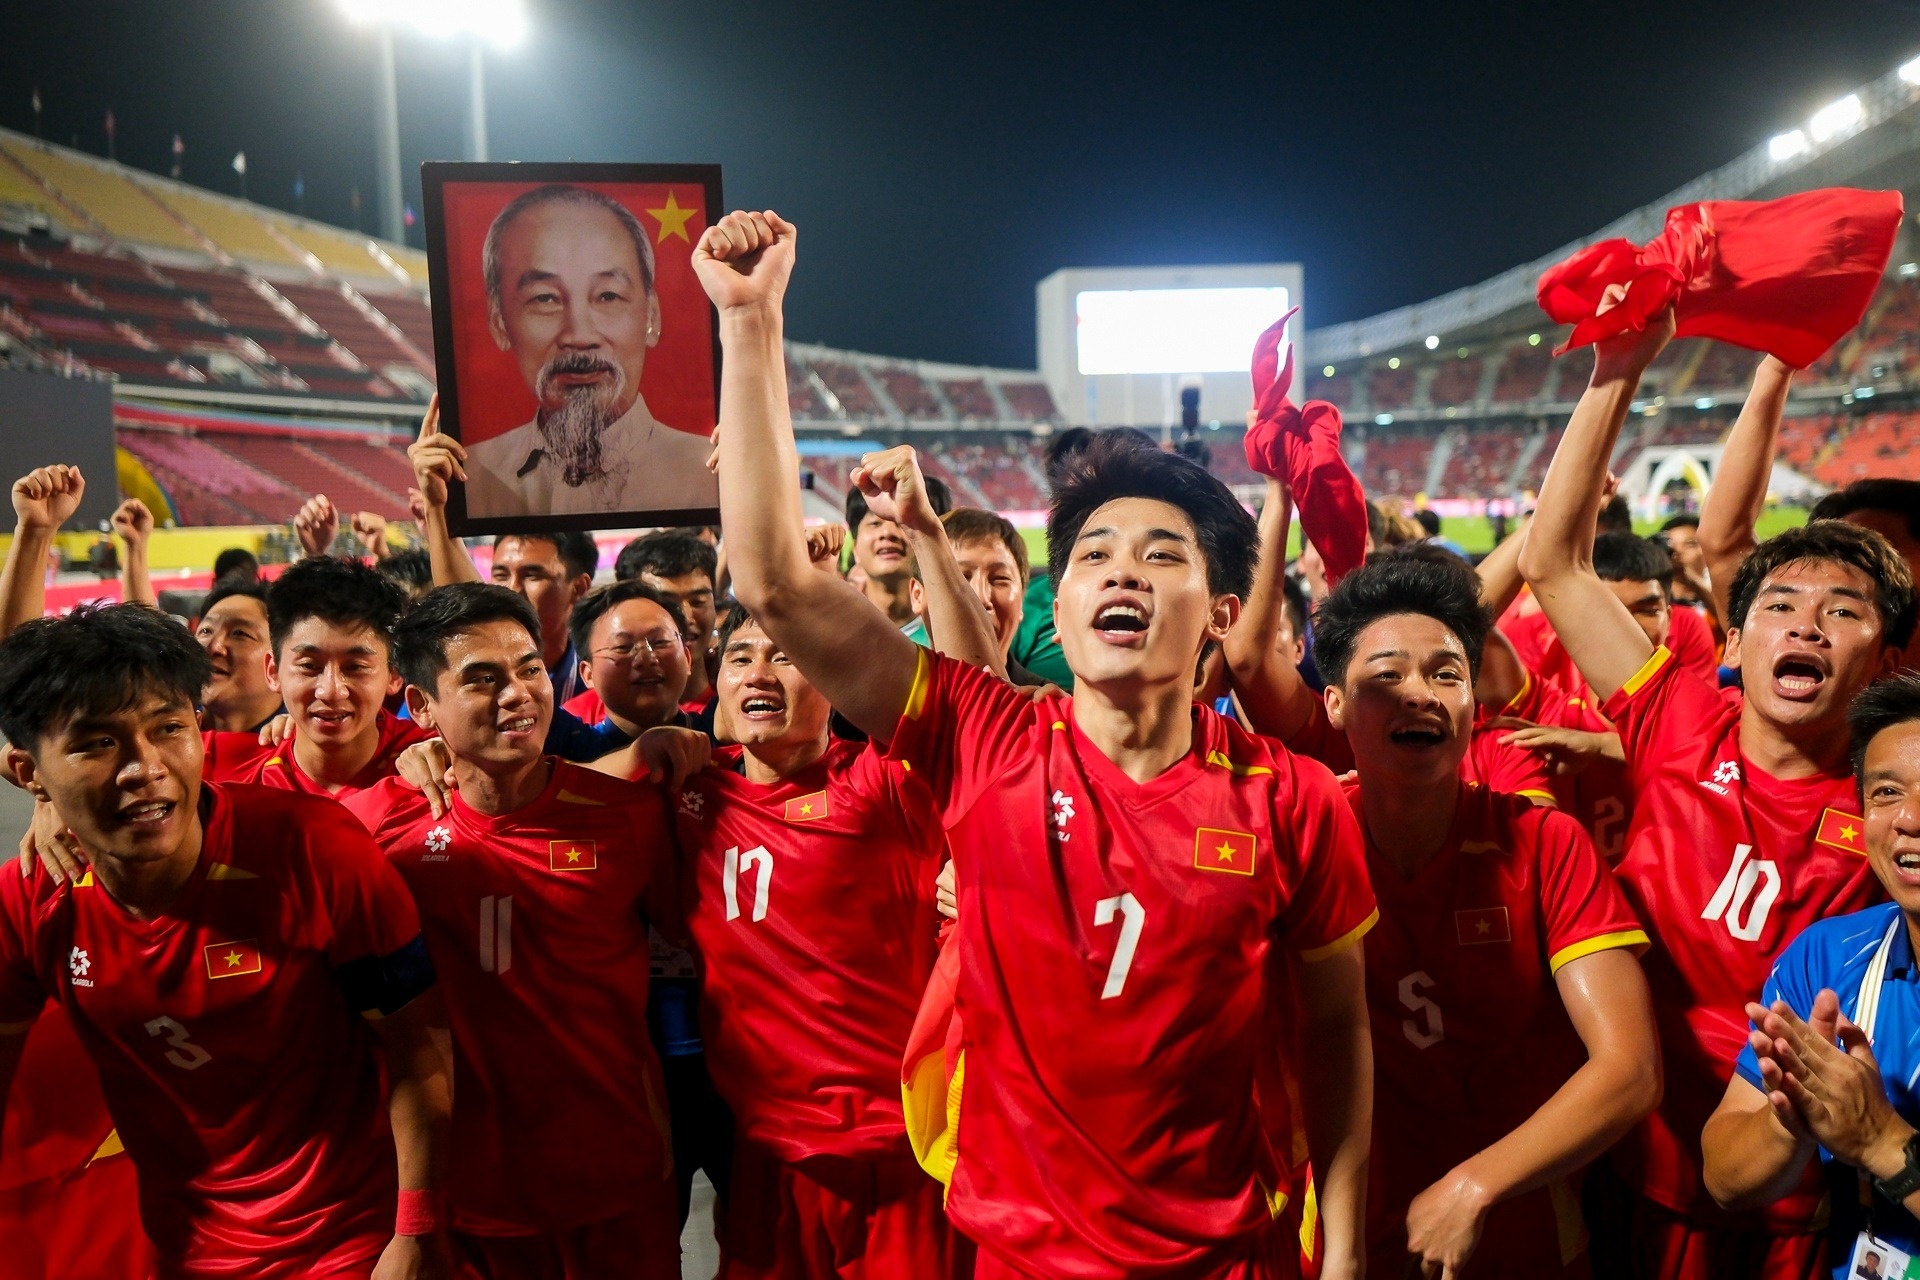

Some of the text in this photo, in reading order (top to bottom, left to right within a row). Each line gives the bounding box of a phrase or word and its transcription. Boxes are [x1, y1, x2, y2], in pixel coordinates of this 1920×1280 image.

[1594, 795, 1625, 857] 2
[722, 845, 774, 922] 17
[1701, 843, 1782, 942] 10
[479, 895, 512, 975] 11
[1094, 892, 1146, 999] 7
[144, 1015, 212, 1071] 3
